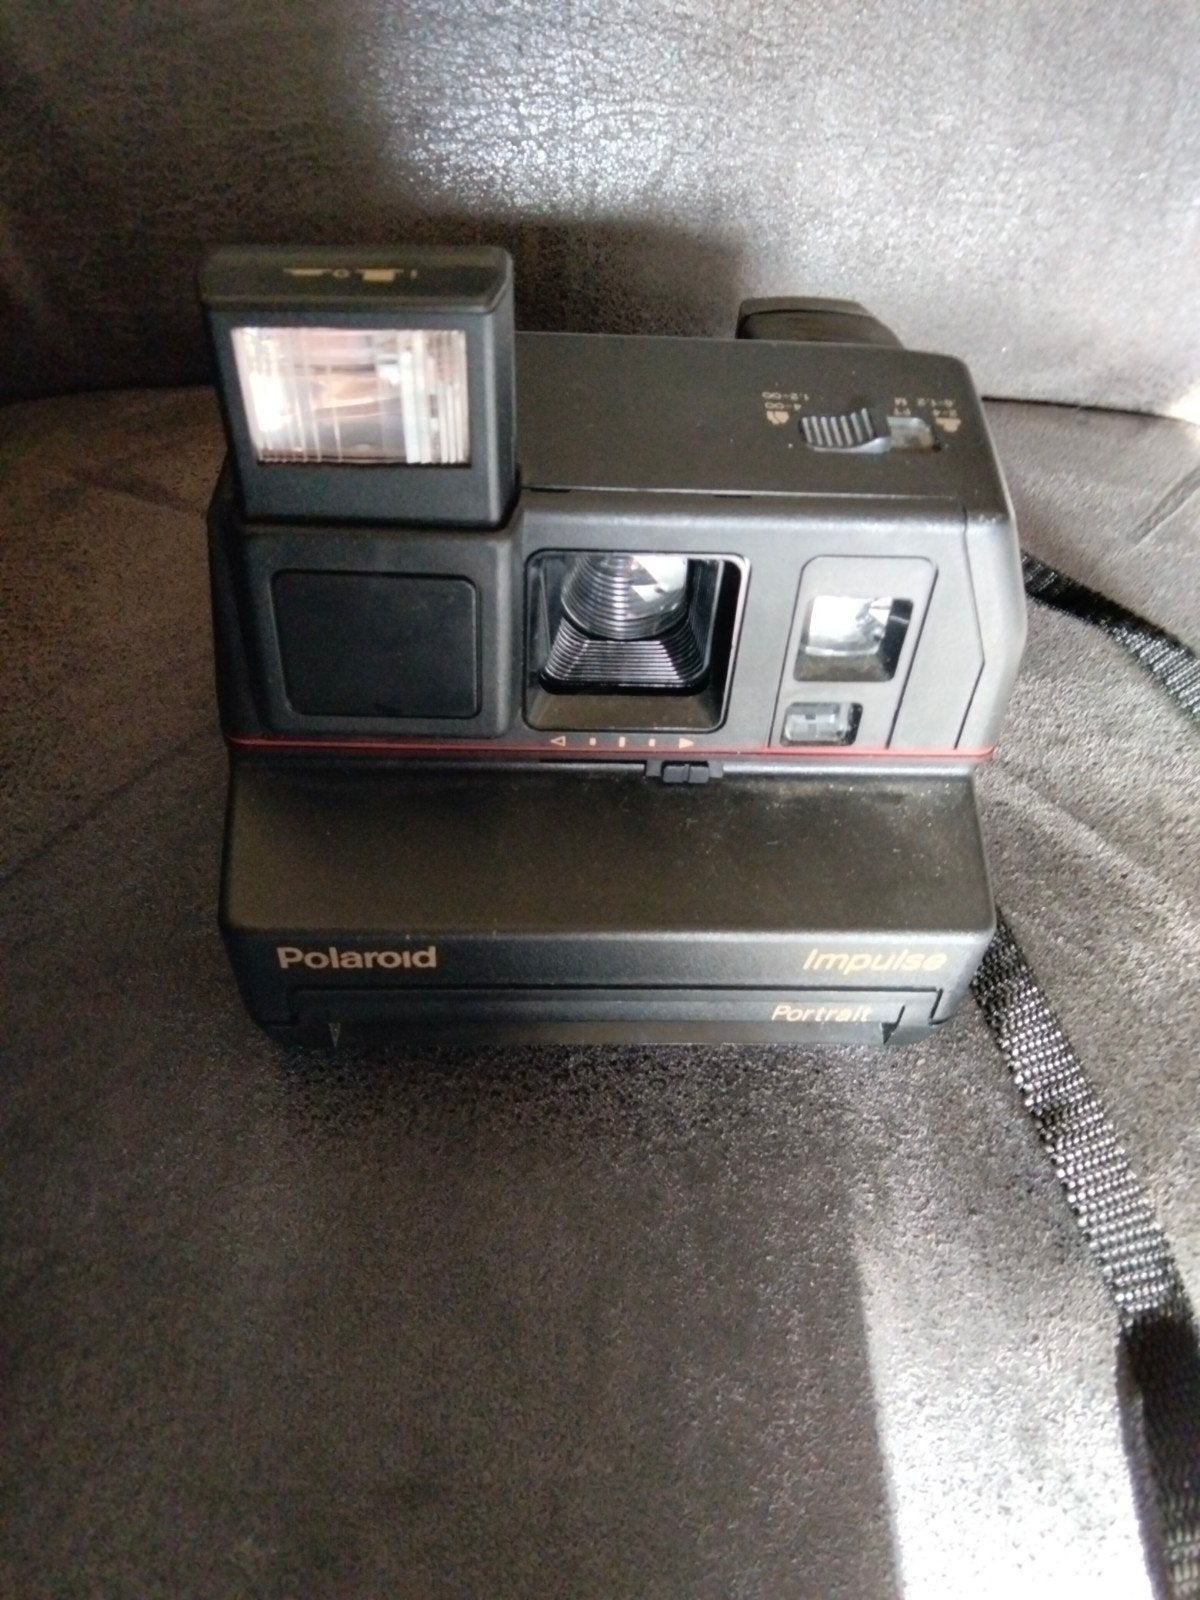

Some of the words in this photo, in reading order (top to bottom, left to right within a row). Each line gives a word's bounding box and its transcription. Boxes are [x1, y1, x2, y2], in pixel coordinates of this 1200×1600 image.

[276, 945, 437, 969] Polaroid
[802, 948, 948, 975] Impulse
[771, 1005, 873, 1022] Portrait
